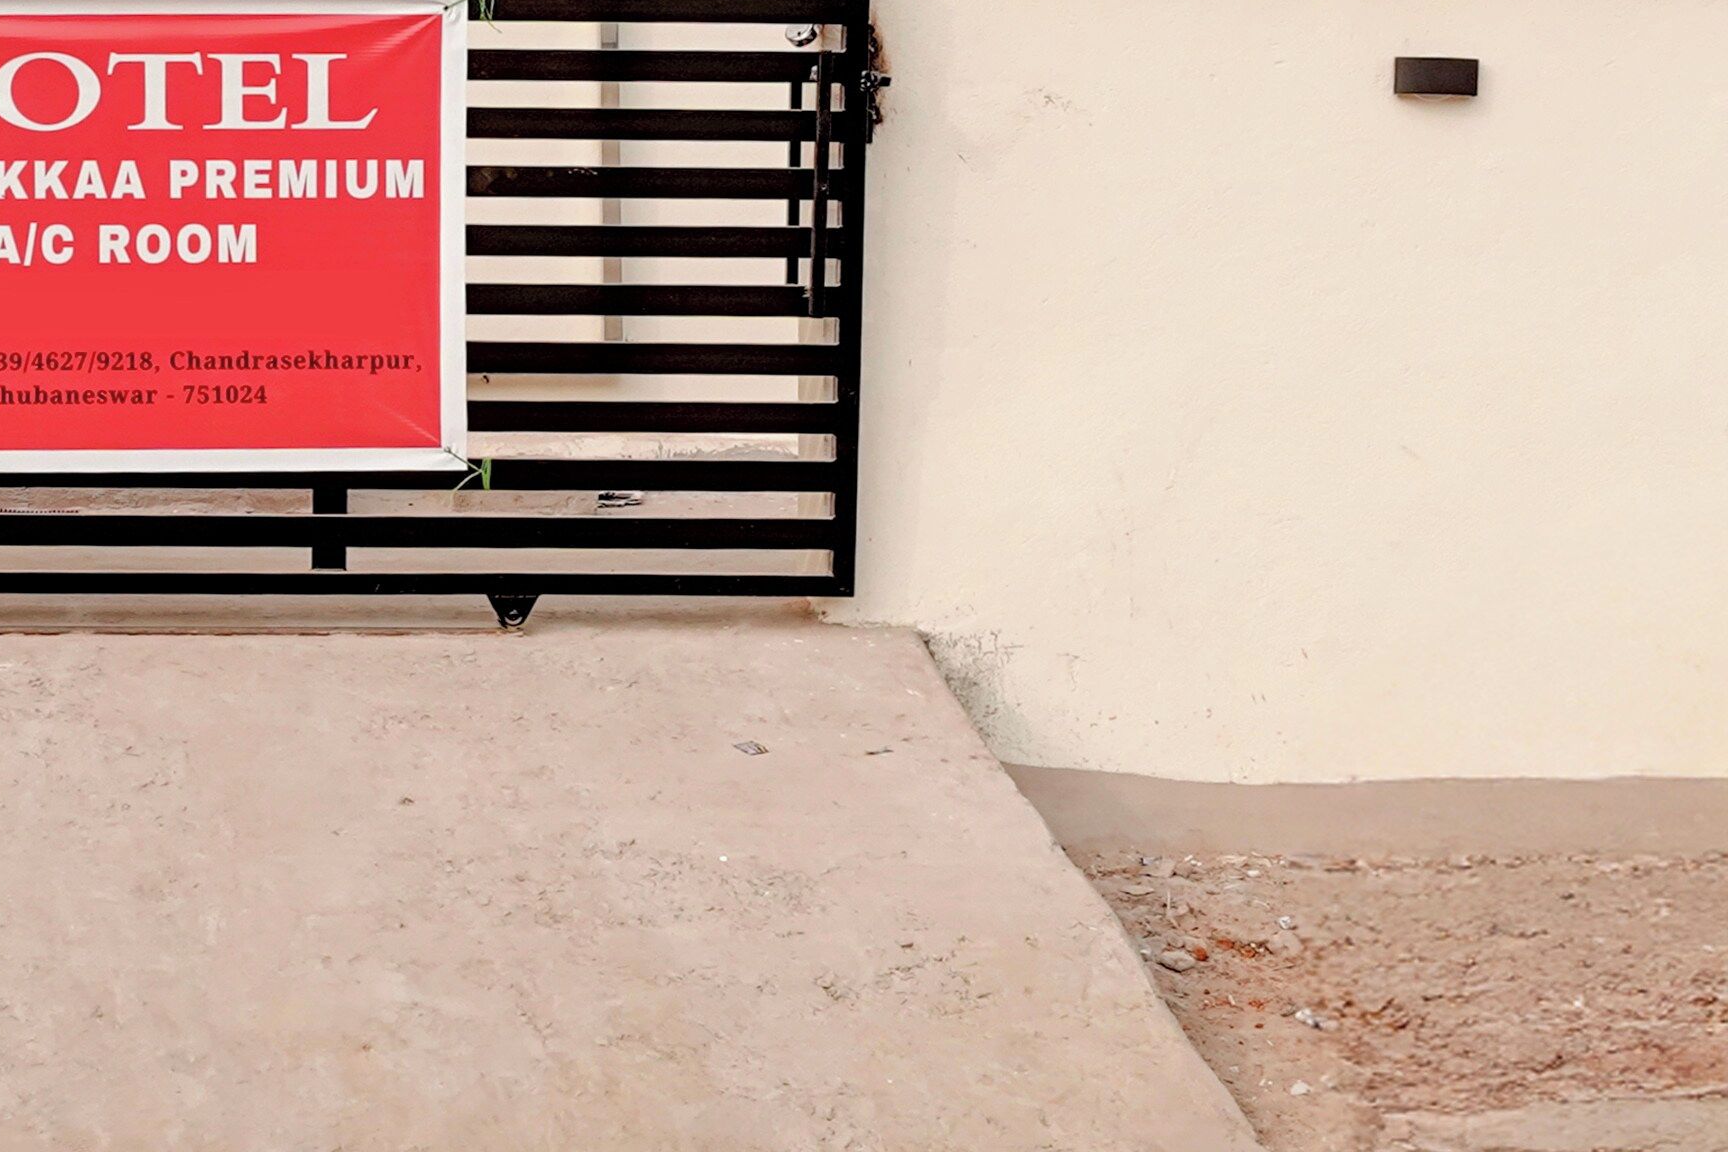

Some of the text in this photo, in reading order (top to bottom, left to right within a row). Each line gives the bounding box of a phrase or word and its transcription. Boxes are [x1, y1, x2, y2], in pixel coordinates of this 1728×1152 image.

[169, 159, 425, 199] PREMIUM
[99, 223, 258, 264] ROOM
[169, 349, 422, 375] Chandrasekharpur,
[182, 384, 268, 405] 751024
